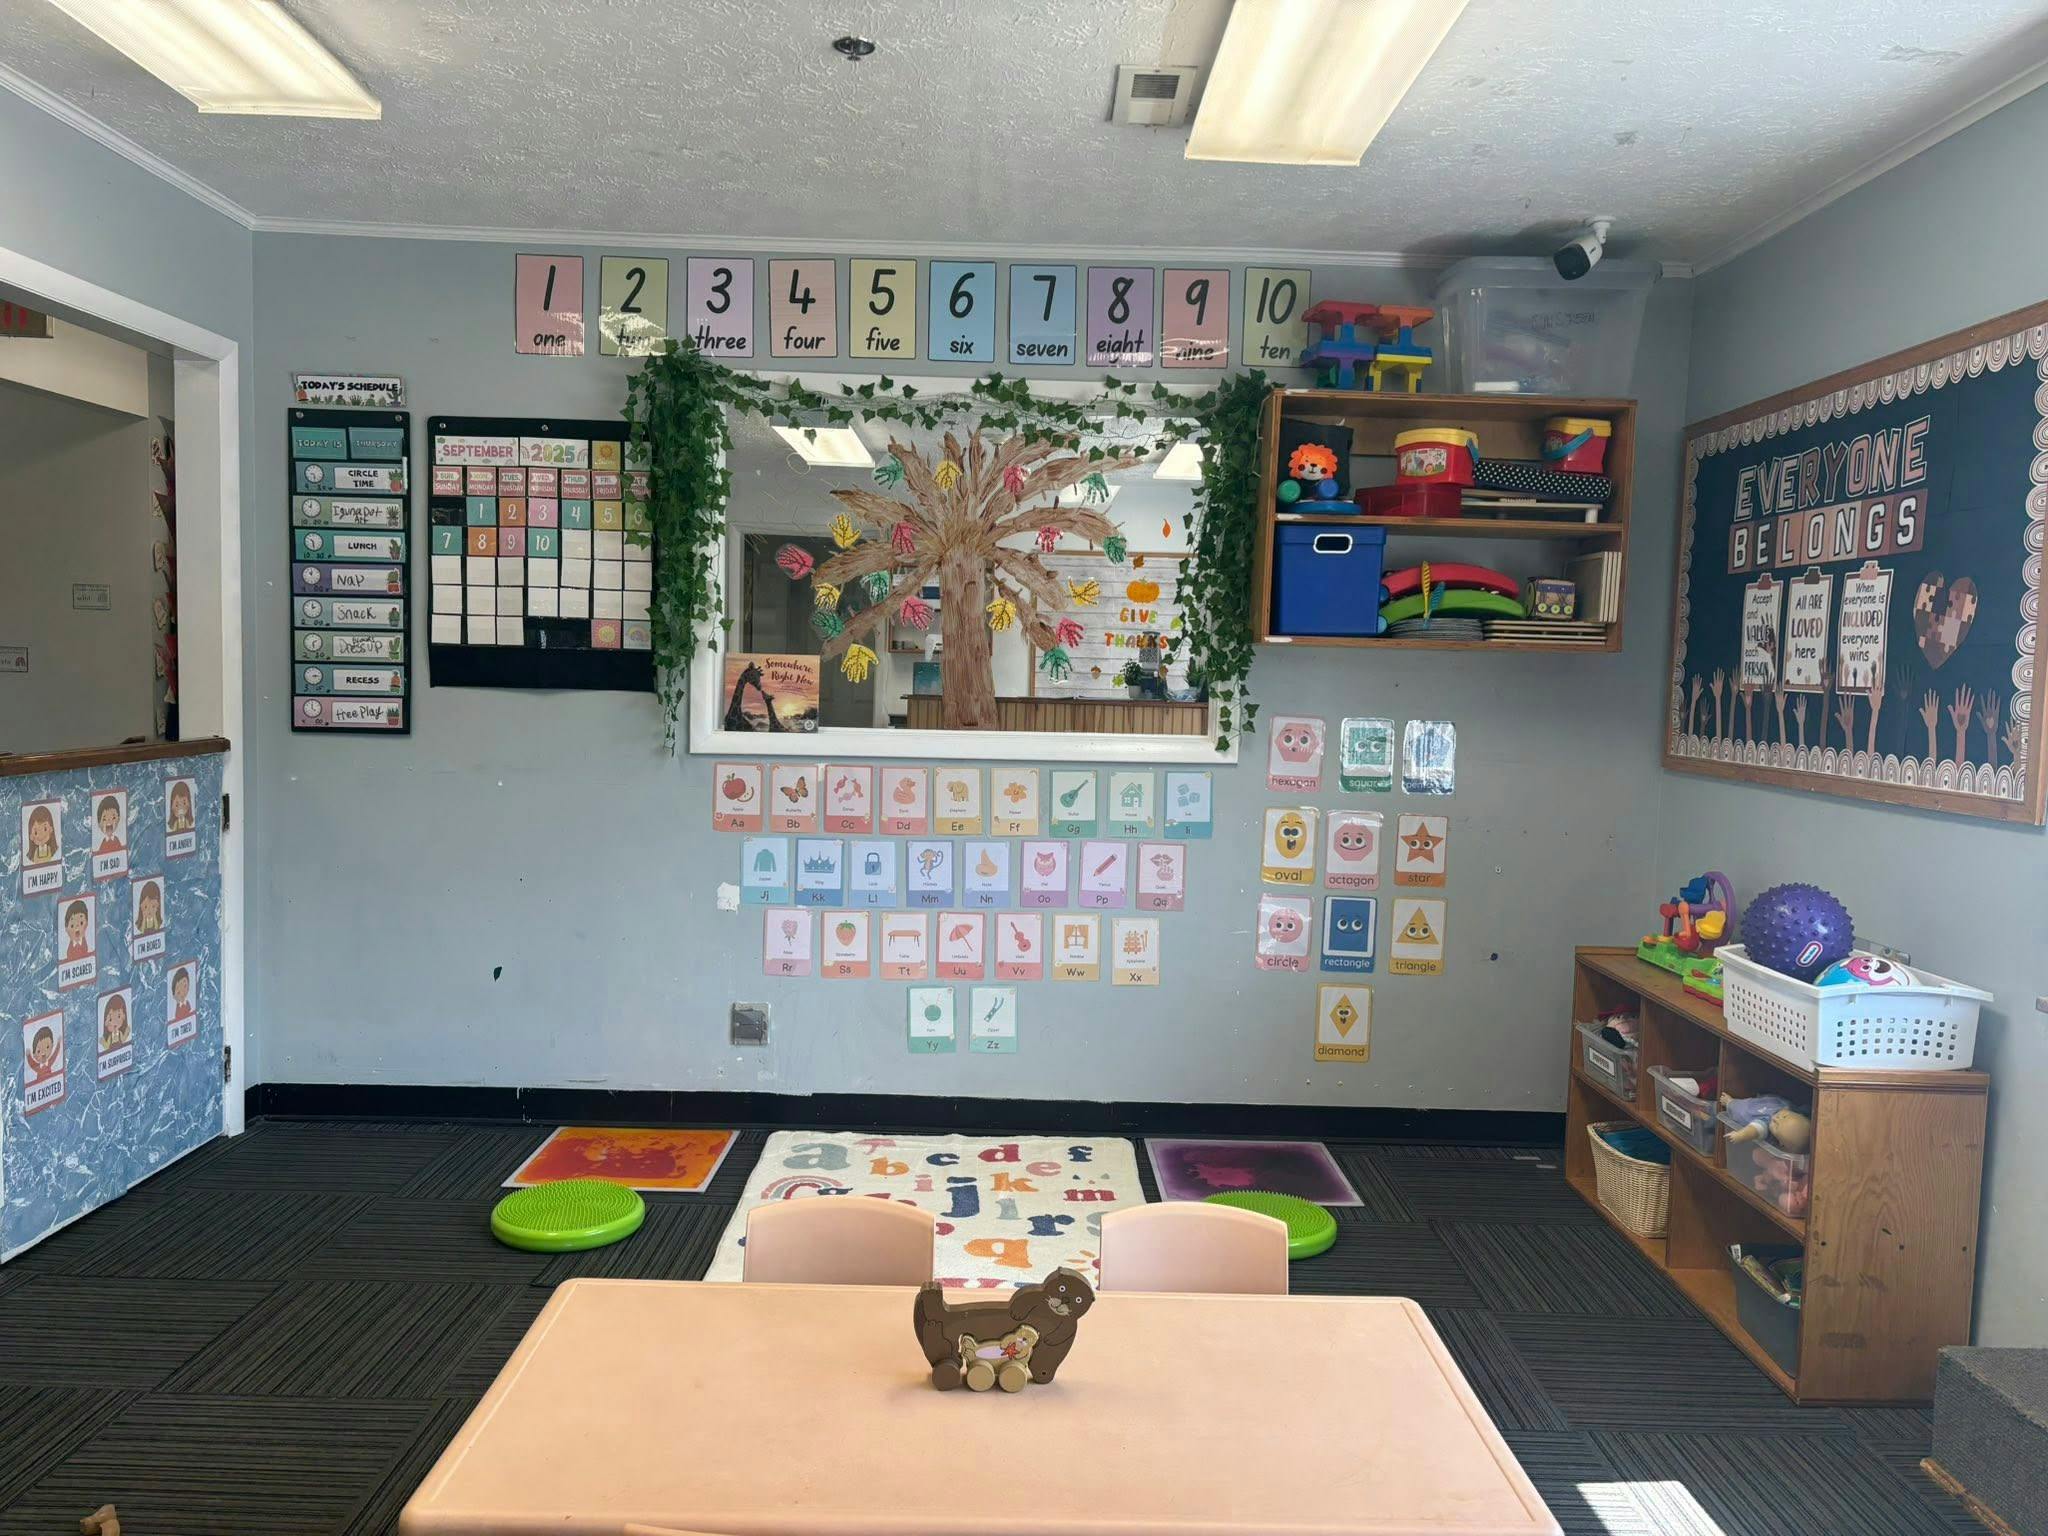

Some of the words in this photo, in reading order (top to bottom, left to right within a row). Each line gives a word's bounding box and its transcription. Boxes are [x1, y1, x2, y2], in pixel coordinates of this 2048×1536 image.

[543, 264, 556, 311] 1
[620, 267, 646, 313] 2
[706, 267, 733, 314] 3
[789, 268, 816, 314] 4
[868, 268, 896, 315] 5
[949, 272, 975, 318] 6
[1033, 274, 1056, 321] 7
[1108, 276, 1134, 324] 8
[1185, 279, 1210, 326] 9
[1256, 277, 1297, 325] 10
[533, 333, 566, 347] one
[695, 324, 746, 350] three
[783, 325, 826, 349] four
[865, 326, 900, 351] five
[949, 334, 974, 354] six
[1016, 342, 1068, 357] seven
[1096, 329, 1144, 364] eight
[1175, 341, 1214, 361] nine
[1260, 335, 1291, 359] ten
[301, 381, 345, 391] TODAY'S
[347, 382, 399, 392] SCHEDULE
[442, 445, 513, 457] SEPTEMBER
[531, 444, 576, 463] 2025
[1734, 415, 1930, 522] EVERYONE
[353, 480, 375, 488] TIME
[562, 486, 588, 494] THURSDAY
[596, 487, 617, 495] FRIDAY
[479, 503, 483, 518] 1
[508, 504, 517, 520] 2
[538, 504, 548, 520] 3
[571, 506, 581, 522] 4
[604, 507, 613, 523] 5
[634, 508, 642, 524] 6
[1733, 496, 1917, 568] BELONGS
[442, 532, 451, 549] 7
[478, 533, 487, 550] 8
[507, 534, 516, 550] 9
[536, 535, 550, 551] 10
[337, 575, 365, 587] Nap
[1856, 583, 1875, 593] When
[1752, 594, 1773, 606] Accept
[1809, 594, 1823, 609] ARE
[1844, 595, 1877, 607] everyone
[1879, 592, 1885, 604] is
[337, 605, 376, 620] Snack
[1119, 607, 1158, 624] GIVE
[1843, 610, 1883, 627] INCLUDED
[1746, 624, 1770, 641] VALUE
[1791, 617, 1823, 638] LOVED
[1105, 631, 1168, 650] THANKS
[1842, 634, 1879, 648] everyone
[1795, 642, 1816, 659] here
[1850, 647, 1869, 661] wins
[765, 658, 814, 674] Somewhere
[771, 671, 794, 682] Right
[795, 675, 814, 686] Now
[1272, 777, 1316, 790] hexagon
[731, 819, 745, 829] Aa
[787, 819, 800, 829] Bb
[841, 820, 855, 830] Cc
[896, 821, 911, 831] Dd
[951, 822, 964, 831] Ee
[1009, 823, 1021, 833] Ff
[1067, 824, 1081, 835] Gg
[1124, 824, 1138, 834] Hh
[100, 859, 109, 871] I'M
[110, 858, 120, 869] SAD
[27, 875, 38, 888] I'M
[39, 871, 59, 886] HAPPY
[1274, 871, 1302, 881] oval
[1328, 876, 1374, 887] octagon
[1408, 873, 1431, 883] star
[760, 891, 770, 901] Jj
[812, 891, 825, 901] Kk
[921, 894, 939, 904] Mm
[980, 895, 994, 904] Nn
[1037, 895, 1051, 904] Oo
[1096, 895, 1109, 905] Pp
[1153, 897, 1168, 908] Qq
[137, 944, 146, 954] I'M
[782, 963, 793, 972] Rr
[839, 965, 851, 974] Ss
[1267, 956, 1299, 968] circle
[1324, 958, 1370, 969] rectangle
[1395, 960, 1436, 972] triangle
[61, 969, 71, 981] I'M
[72, 963, 93, 979] SCARED
[898, 967, 911, 976] Tt
[953, 967, 967, 975] Uu
[1012, 967, 1026, 975] Vv
[1066, 968, 1085, 977] Ww
[1129, 972, 1142, 982] Xx
[171, 1026, 180, 1038] I'M
[926, 1041, 939, 1052] Yy
[987, 1040, 1000, 1049] Zz
[1317, 1046, 1365, 1057] diamond
[99, 1061, 107, 1071] I'M
[108, 1052, 132, 1069] SURPRISED
[27, 1091, 37, 1105] I'M
[37, 1081, 61, 1101] EXCITED
[783, 1143, 850, 1170] a
[926, 1153, 960, 1166] c
[978, 1143, 1021, 1162] d
[1067, 1145, 1093, 1162] f
[870, 1156, 910, 1176] b
[1025, 1161, 1062, 1176] e
[914, 1174, 934, 1192] i
[990, 1172, 1039, 1193] k
[940, 1176, 980, 1218] j
[1063, 1188, 1117, 1202] m
[1027, 1214, 1075, 1236] r
[964, 1238, 1033, 1268] q
